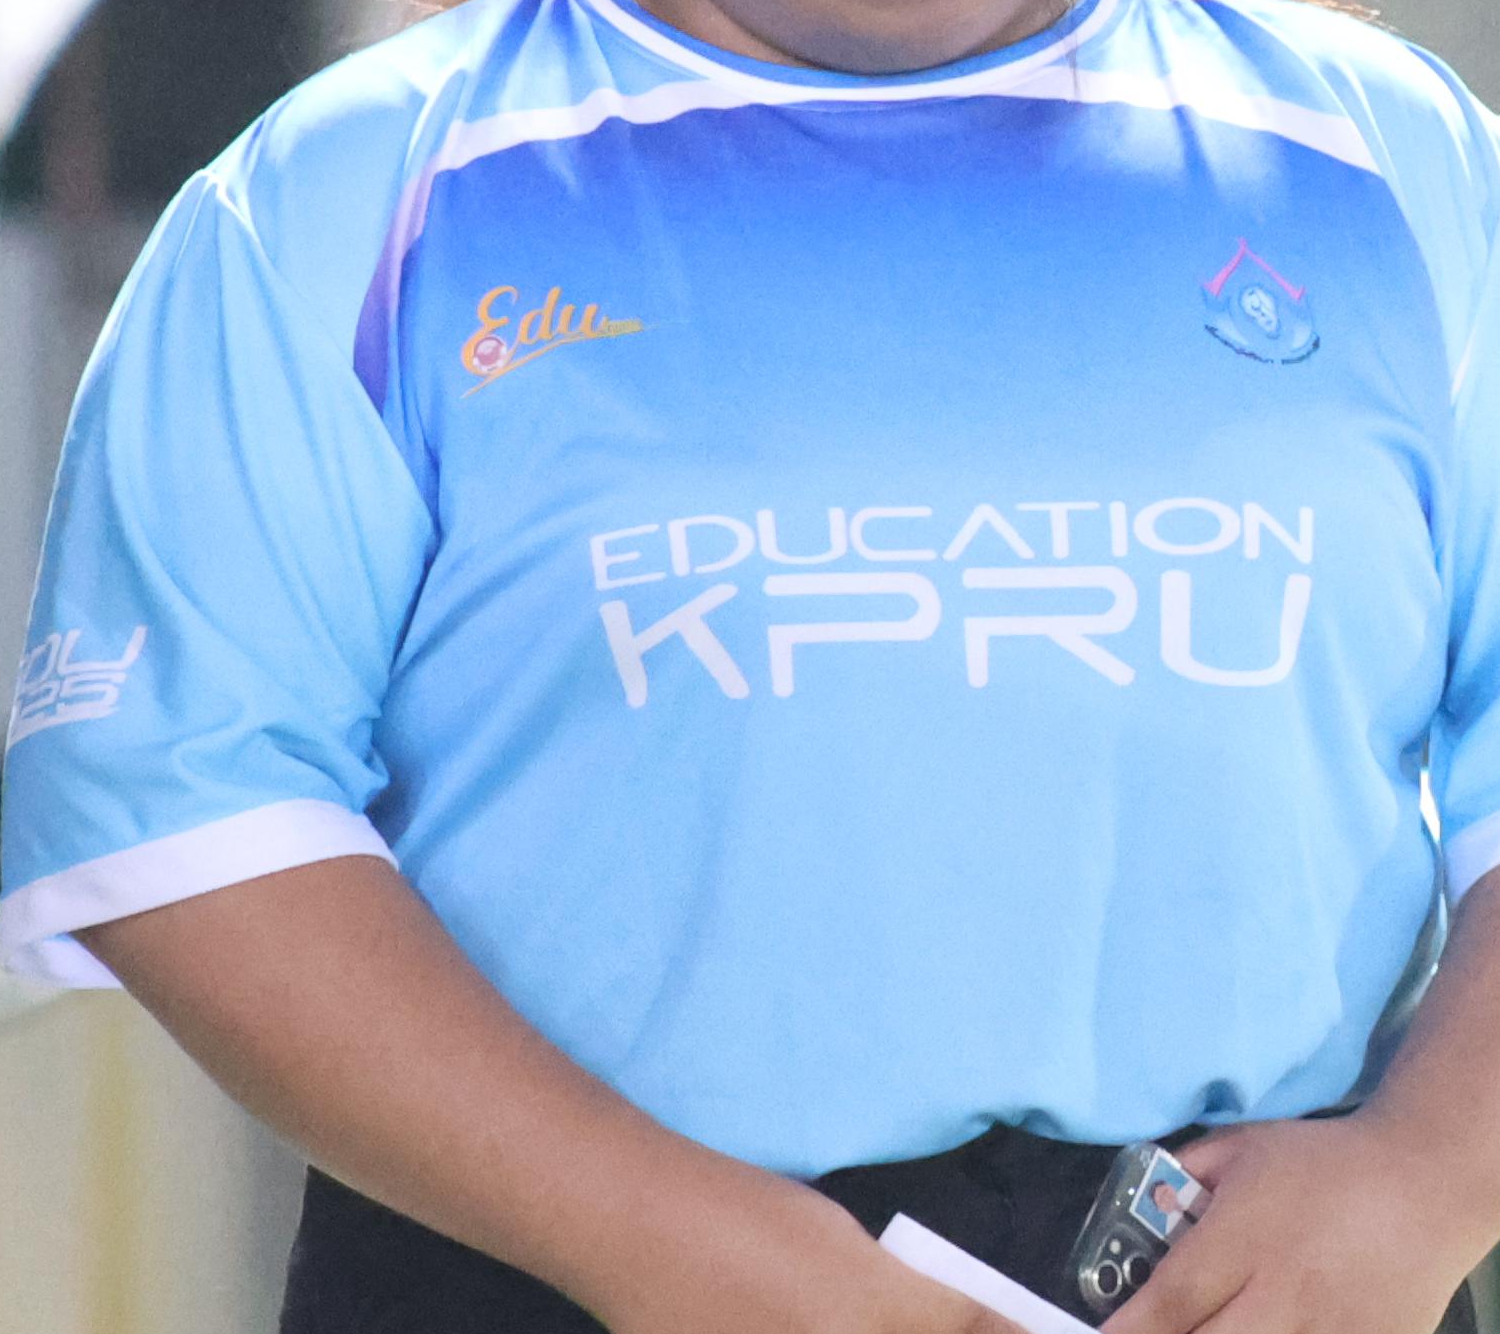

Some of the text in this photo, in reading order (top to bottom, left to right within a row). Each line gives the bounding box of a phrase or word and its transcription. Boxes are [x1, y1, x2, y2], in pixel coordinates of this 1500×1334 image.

[461, 285, 600, 378] Edu
[590, 497, 1314, 591] EDUCATION
[599, 565, 1313, 709] KPRU
